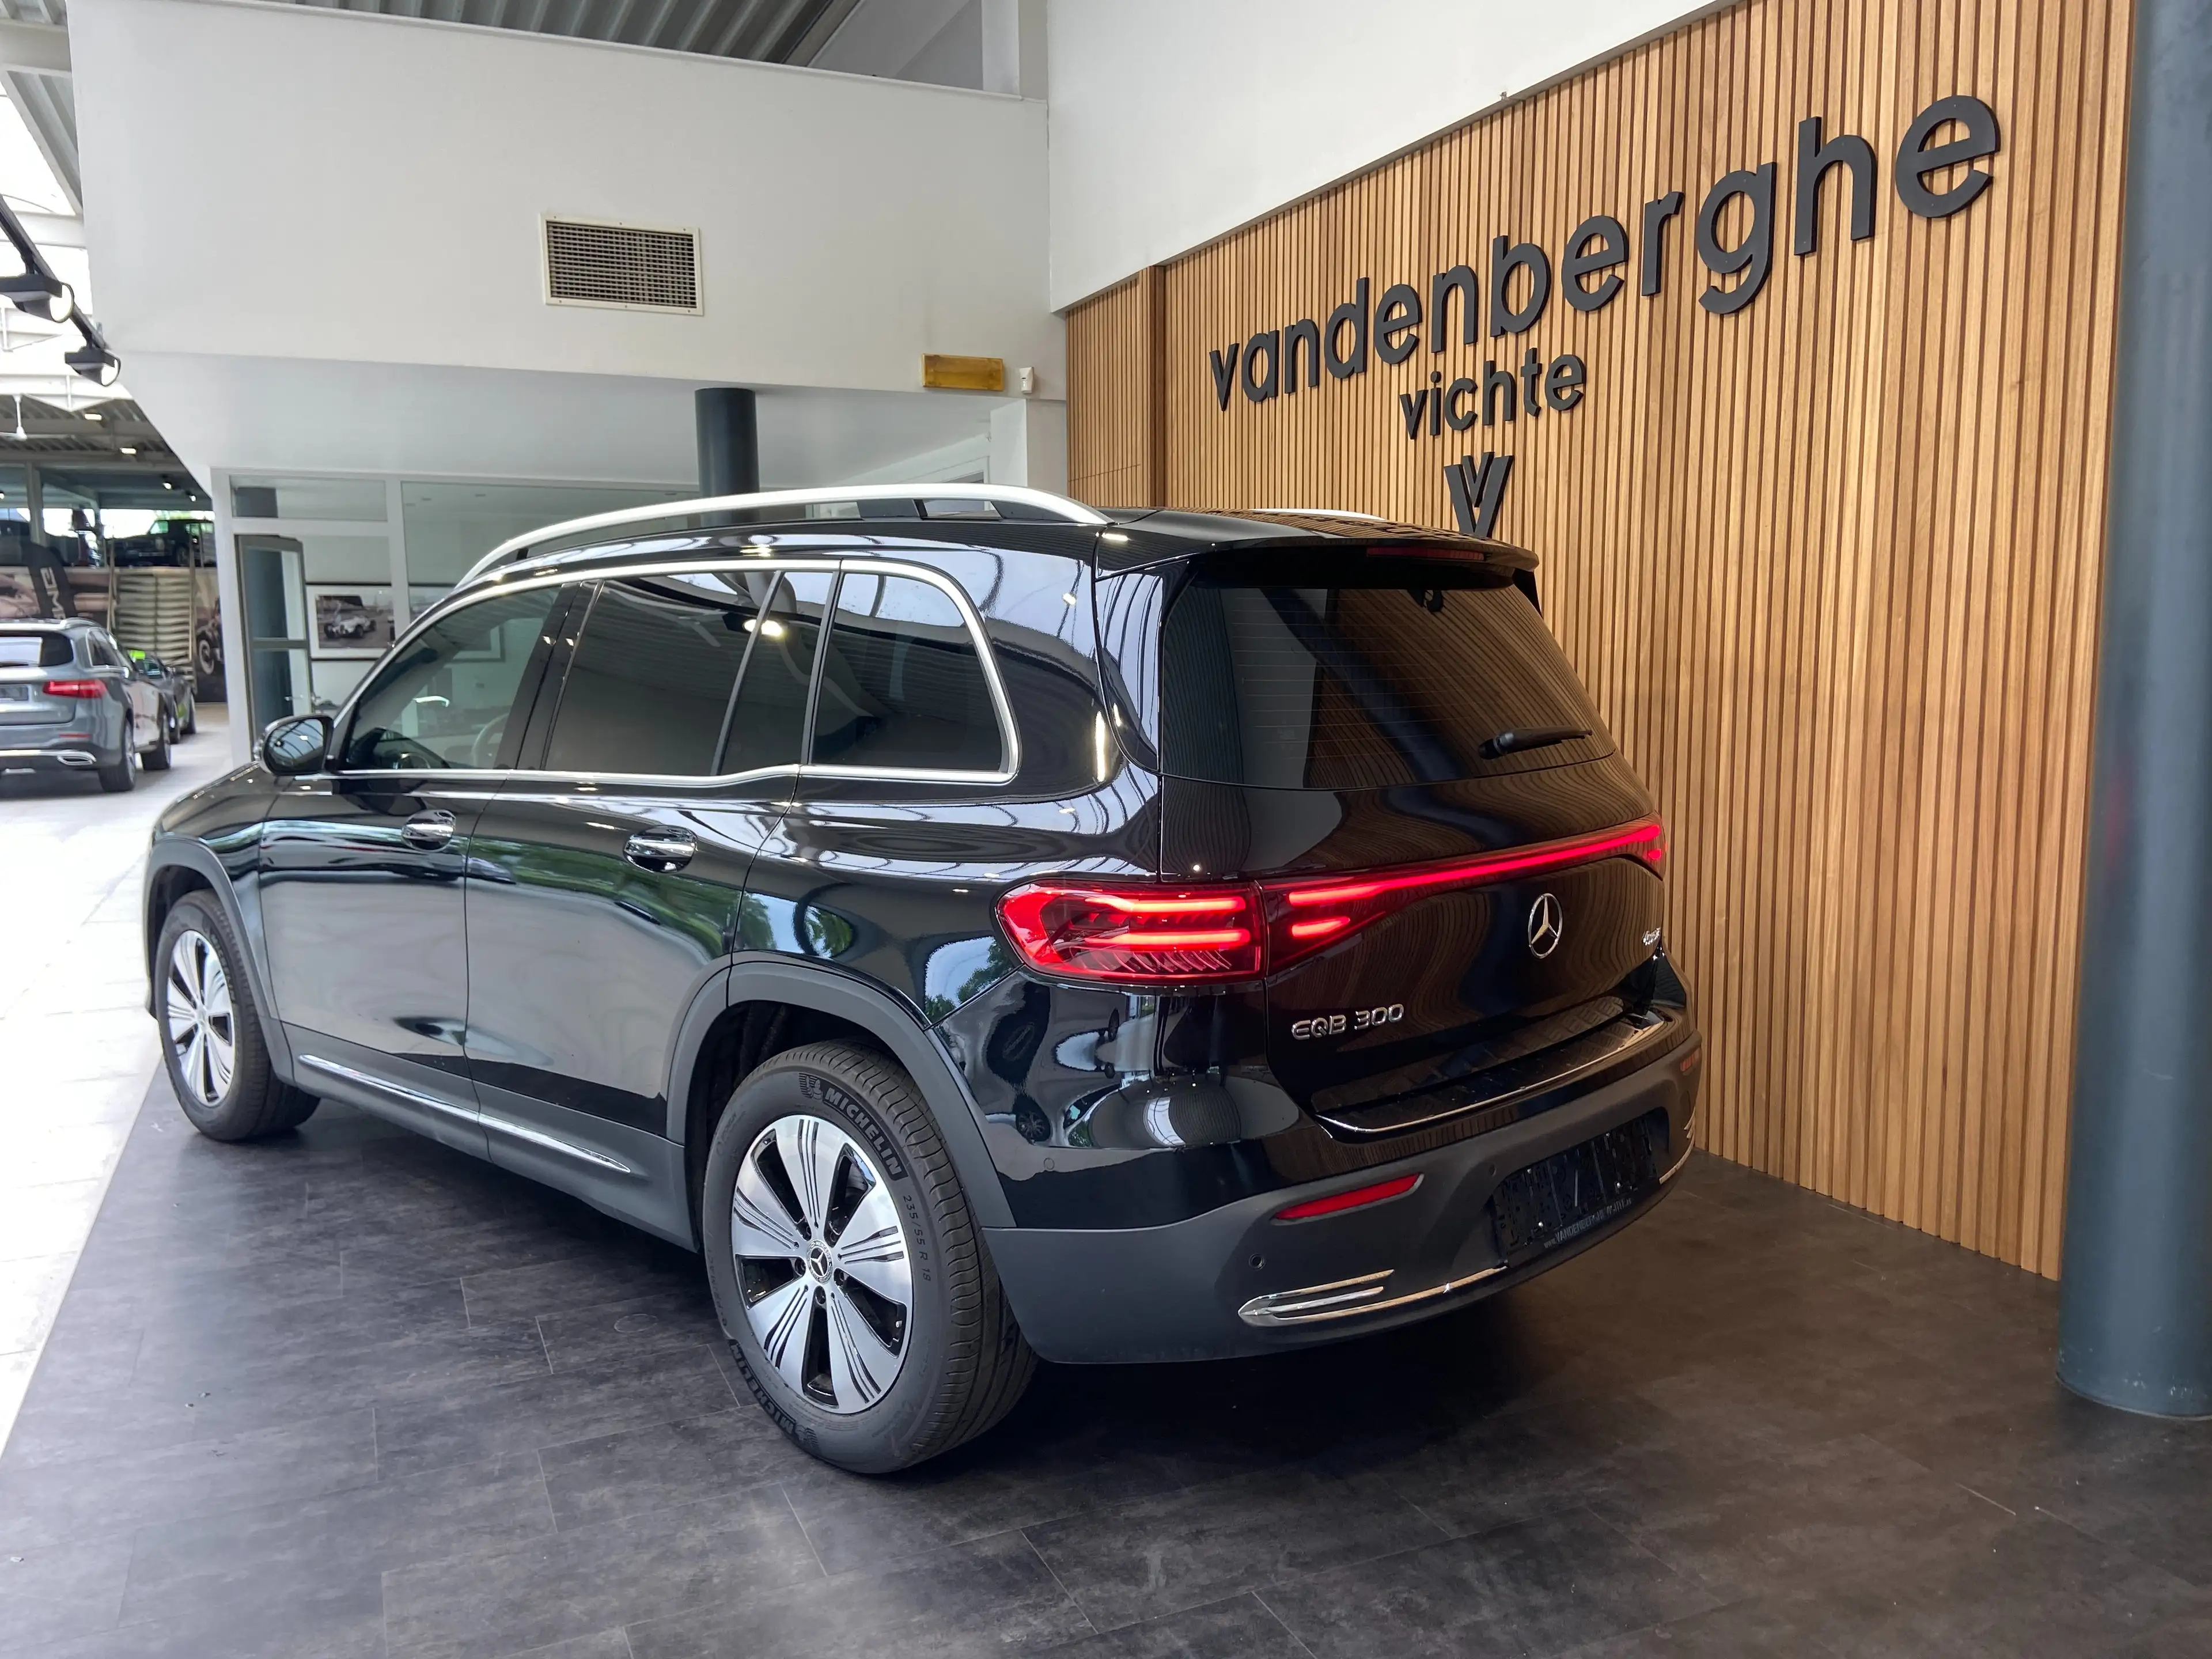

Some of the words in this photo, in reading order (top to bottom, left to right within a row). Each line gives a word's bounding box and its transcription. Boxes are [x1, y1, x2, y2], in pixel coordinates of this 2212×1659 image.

[1209, 95, 2001, 412] vandenberghe
[1400, 347, 1587, 440] vichte
[1291, 1014, 1346, 1040] EQB
[1354, 1003, 1404, 1030] 300
[824, 1087, 902, 1176] MICHELIN
[903, 1195, 925, 1245] 235/55
[919, 1251, 928, 1260] R
[922, 1268, 931, 1282] 18
